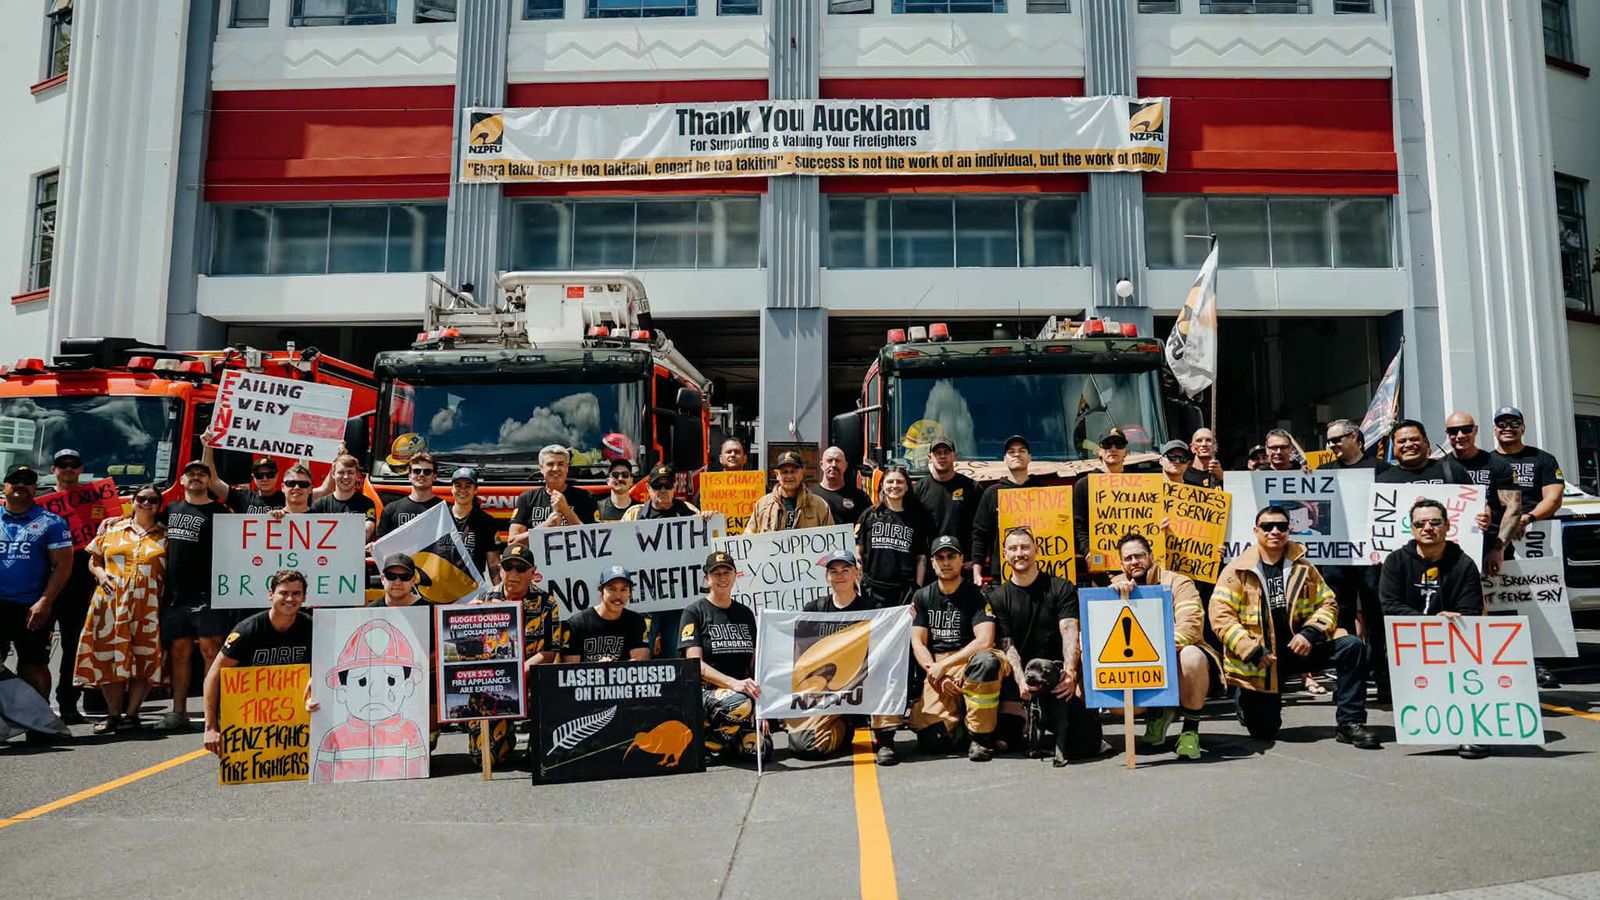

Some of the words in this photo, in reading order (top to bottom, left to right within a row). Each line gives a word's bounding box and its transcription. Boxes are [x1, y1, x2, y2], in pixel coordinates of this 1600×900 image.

[676, 107, 751, 136] Thank
[759, 106, 804, 132] You
[813, 104, 930, 132] Auckland
[690, 139, 707, 151] For
[710, 136, 769, 151] Supporting
[772, 136, 779, 147] &
[783, 135, 822, 149] Valuing
[826, 135, 850, 147] Your
[853, 134, 917, 148] Firefighters
[1130, 133, 1164, 142] NZPFU
[468, 145, 502, 154] NZPFU
[509, 163, 533, 176] taku
[538, 165, 556, 176] toa
[567, 164, 578, 176] te
[582, 164, 600, 176] toa
[604, 161, 651, 176] takitahi,
[655, 160, 692, 174] engari
[696, 159, 710, 173] he
[714, 159, 732, 171] toa
[795, 155, 845, 169] Success
[848, 155, 859, 169] is
[863, 155, 882, 169] not
[885, 155, 904, 169] the
[909, 155, 938, 168] work
[942, 154, 954, 168] of
[957, 156, 972, 168] an
[975, 153, 1036, 169] individual,
[1040, 153, 1059, 167] but
[1063, 152, 1081, 166] the
[1085, 152, 1114, 165] work
[1118, 152, 1128, 165] of
[1132, 151, 1162, 166] many.
[207, 428, 314, 457] ZEALANDER
[1265, 476, 1334, 494] FENZ
[1095, 490, 1107, 503] IF
[1111, 490, 1137, 503] YOU
[1138, 491, 1161, 504] ARE
[1163, 483, 1226, 509] DECADES
[1097, 505, 1153, 519] WAITING
[1176, 502, 1225, 525] SERVICE
[1371, 489, 1397, 552] FENZ
[727, 516, 750, 530] ENZ
[871, 521, 914, 543] DIRE
[1095, 521, 1118, 536] FOR
[1143, 521, 1160, 536] TO
[242, 520, 338, 550] FENZ
[544, 528, 612, 566] FENZ
[636, 519, 708, 552] WITH
[770, 531, 848, 557] SUPPORT
[278, 552, 298, 568] IS
[747, 558, 817, 586] YOUR
[1500, 574, 1559, 587] BREAKING
[548, 577, 590, 612] NO
[1498, 592, 1532, 603] FENZ
[1536, 587, 1562, 603] SAY
[449, 616, 477, 624] BUDGET
[483, 621, 510, 629] DELIVERY
[463, 628, 498, 636] COLLAPSED
[708, 624, 751, 640] DIRE
[584, 636, 624, 654] DIRE
[1392, 622, 1527, 666] FENZ
[253, 646, 306, 666] DIRE
[223, 670, 250, 694] WE
[255, 668, 306, 693] FIGHT
[452, 679, 466, 687] FIRE
[468, 677, 511, 686] APPLIANCES
[558, 668, 605, 688] LASER
[608, 665, 676, 684] FOCUSED
[1099, 670, 1162, 684] CAUTION
[1448, 669, 1484, 695] IS
[475, 685, 504, 693] EXPIRED
[575, 687, 592, 701] ON
[594, 685, 633, 701] FIXING
[635, 684, 662, 698] FENZ
[239, 697, 295, 724] FIRES
[1400, 703, 1538, 739] COOKED
[222, 725, 264, 753] FENZ
[220, 756, 249, 783] FIRE
[252, 752, 310, 780] FIGHTERS
